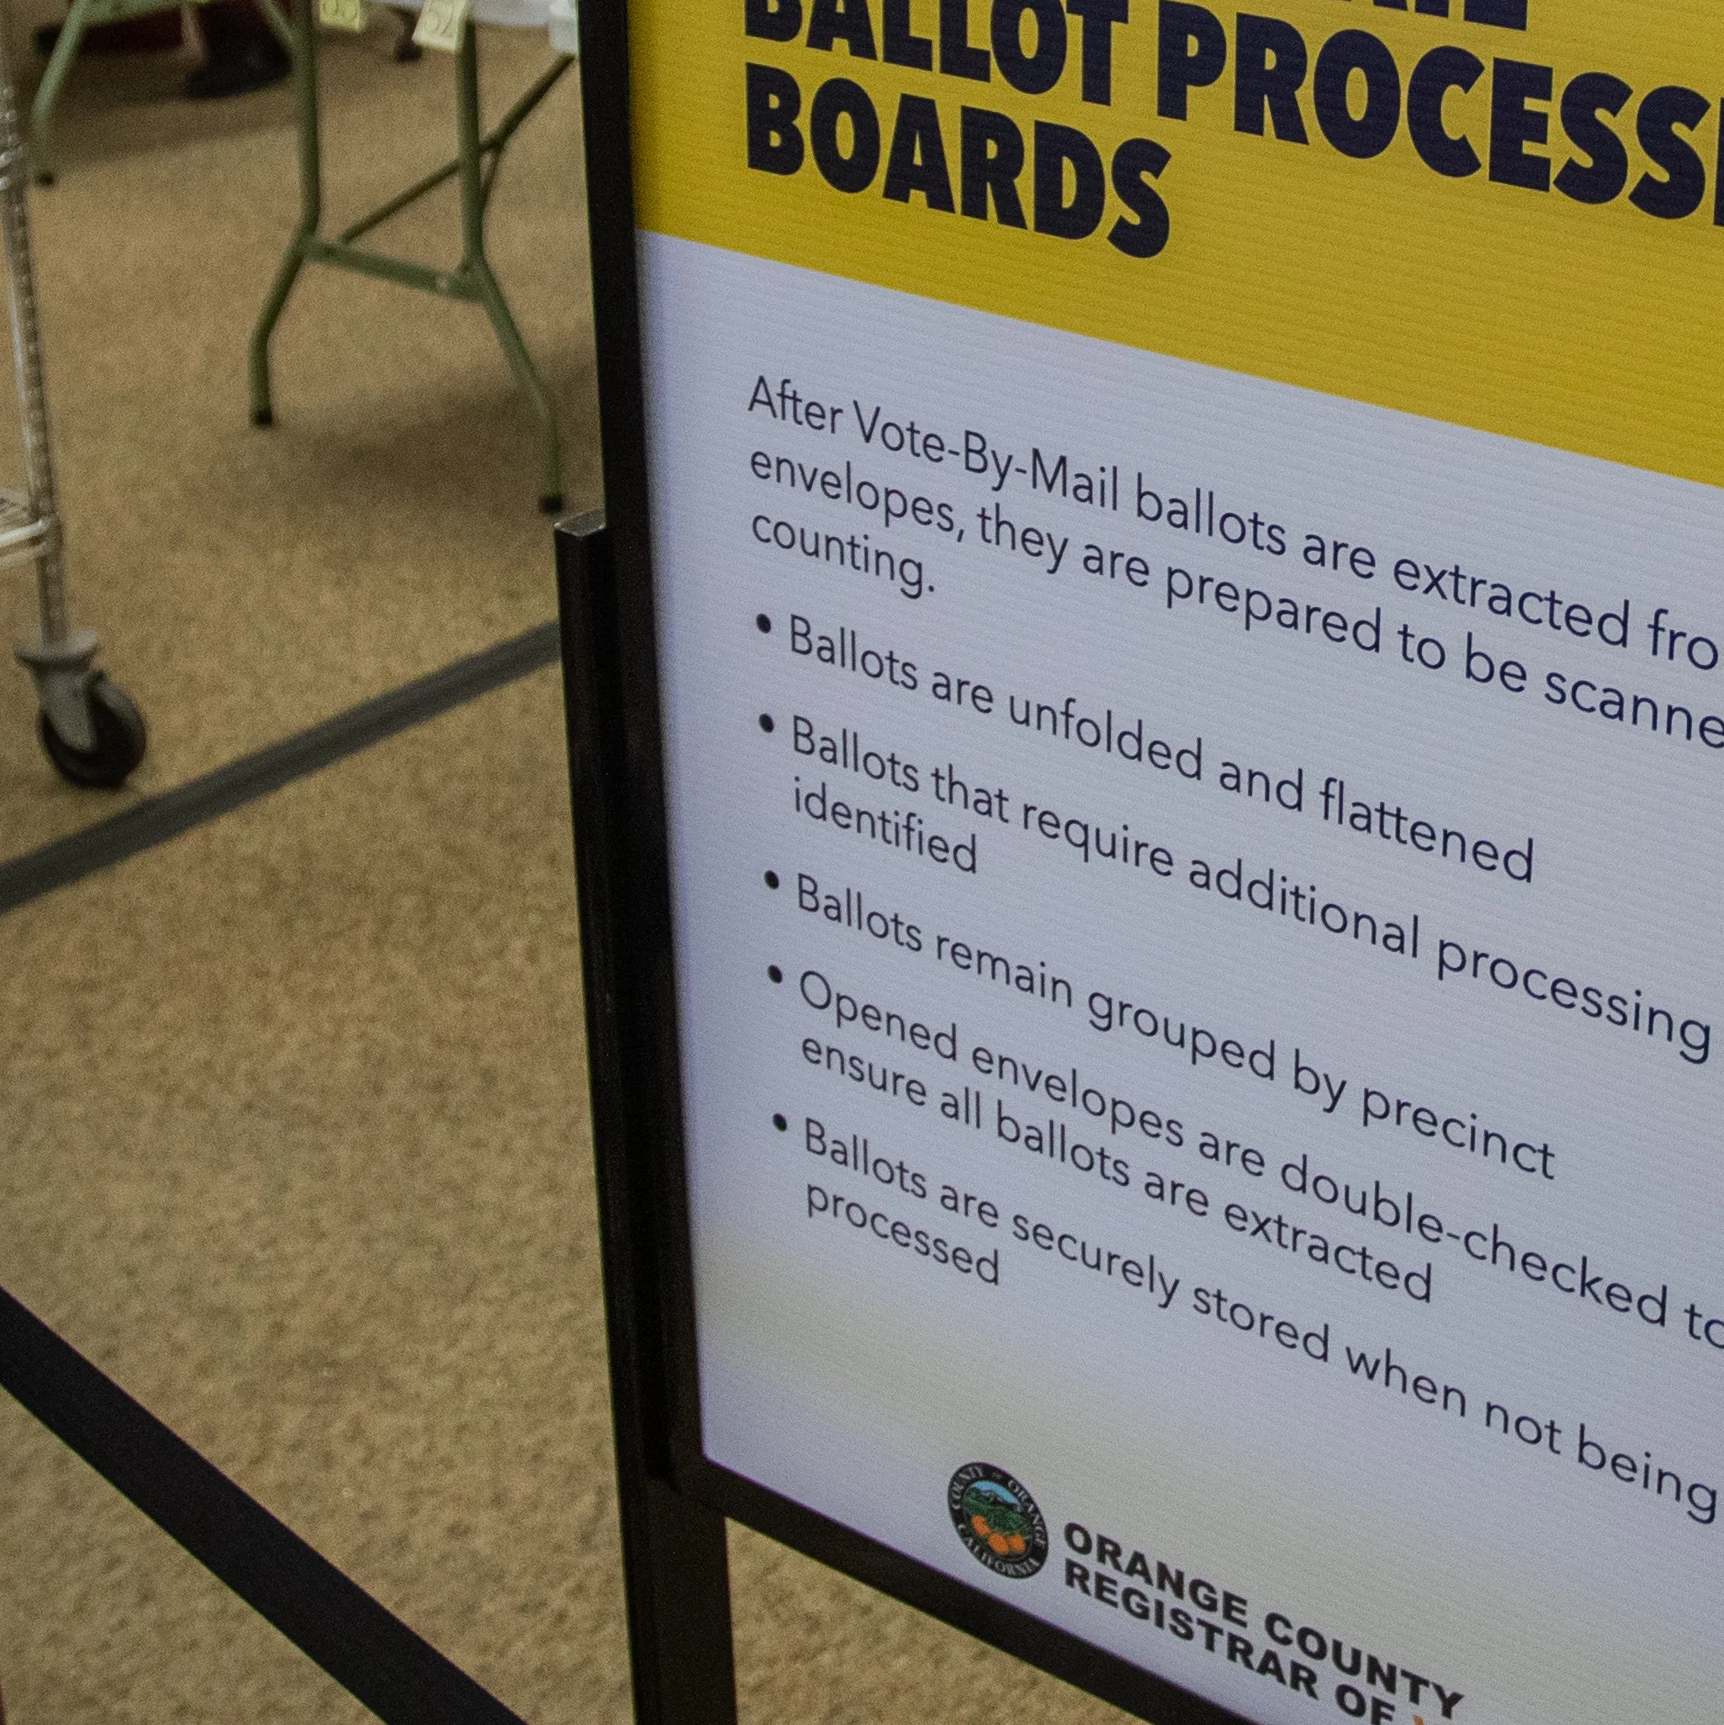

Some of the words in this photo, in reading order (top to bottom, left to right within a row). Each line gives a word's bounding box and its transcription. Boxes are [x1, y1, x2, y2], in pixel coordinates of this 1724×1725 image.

[744, 61, 1173, 261] BOARDS
[747, 374, 844, 435] After
[852, 399, 1119, 512] Vote-By-Mail
[1136, 471, 1287, 557] ballots
[1302, 533, 1377, 580] are
[1392, 557, 1631, 649] extracted
[749, 450, 965, 543] envelopes,
[976, 501, 1070, 576] they
[1082, 543, 1151, 588] are
[1166, 566, 1382, 654] prepared
[1396, 623, 1447, 671] to
[1464, 631, 1528, 694] be
[751, 514, 935, 601] counting.
[789, 613, 919, 691] Ballots
[931, 671, 995, 715] are
[1008, 695, 1203, 782] unfolded
[1218, 760, 1304, 813] and
[1318, 776, 1535, 884] flattened
[794, 781, 978, 875] identified
[792, 714, 920, 793] Ballots
[930, 763, 1010, 824] that
[1022, 803, 1175, 878] require
[1188, 857, 1420, 959] additional
[1437, 938, 1712, 1066] processing
[797, 872, 923, 953] Ballots
[936, 934, 1073, 1008] remain
[1087, 991, 1276, 1082] grouped
[1293, 1047, 1348, 1115] by
[1362, 1087, 1556, 1181] precinct
[799, 969, 958, 1062] Opened
[971, 1046, 1185, 1148] envelopes
[1198, 1130, 1266, 1178] are
[1280, 1153, 1669, 1328] double-checked
[801, 1037, 928, 1107] ensure
[939, 1086, 982, 1130] all
[996, 1098, 1131, 1188] ballots
[1143, 1171, 1210, 1218] are
[1223, 1202, 1433, 1304] extracted
[806, 1183, 1000, 1286] processed
[804, 1116, 928, 1200] Ballots
[939, 1184, 1000, 1229] are
[1012, 1213, 1181, 1310] securely
[1192, 1286, 1330, 1363] stored
[1344, 1346, 1467, 1418] when
[1484, 1401, 1563, 1456] not
[1577, 1422, 1718, 1526] being
[1063, 1521, 1249, 1630] ORANGE
[1263, 1611, 1465, 1720] COUNTY
[1064, 1557, 1320, 1701] REGISTRAR
[1334, 1683, 1397, 1725] OF
